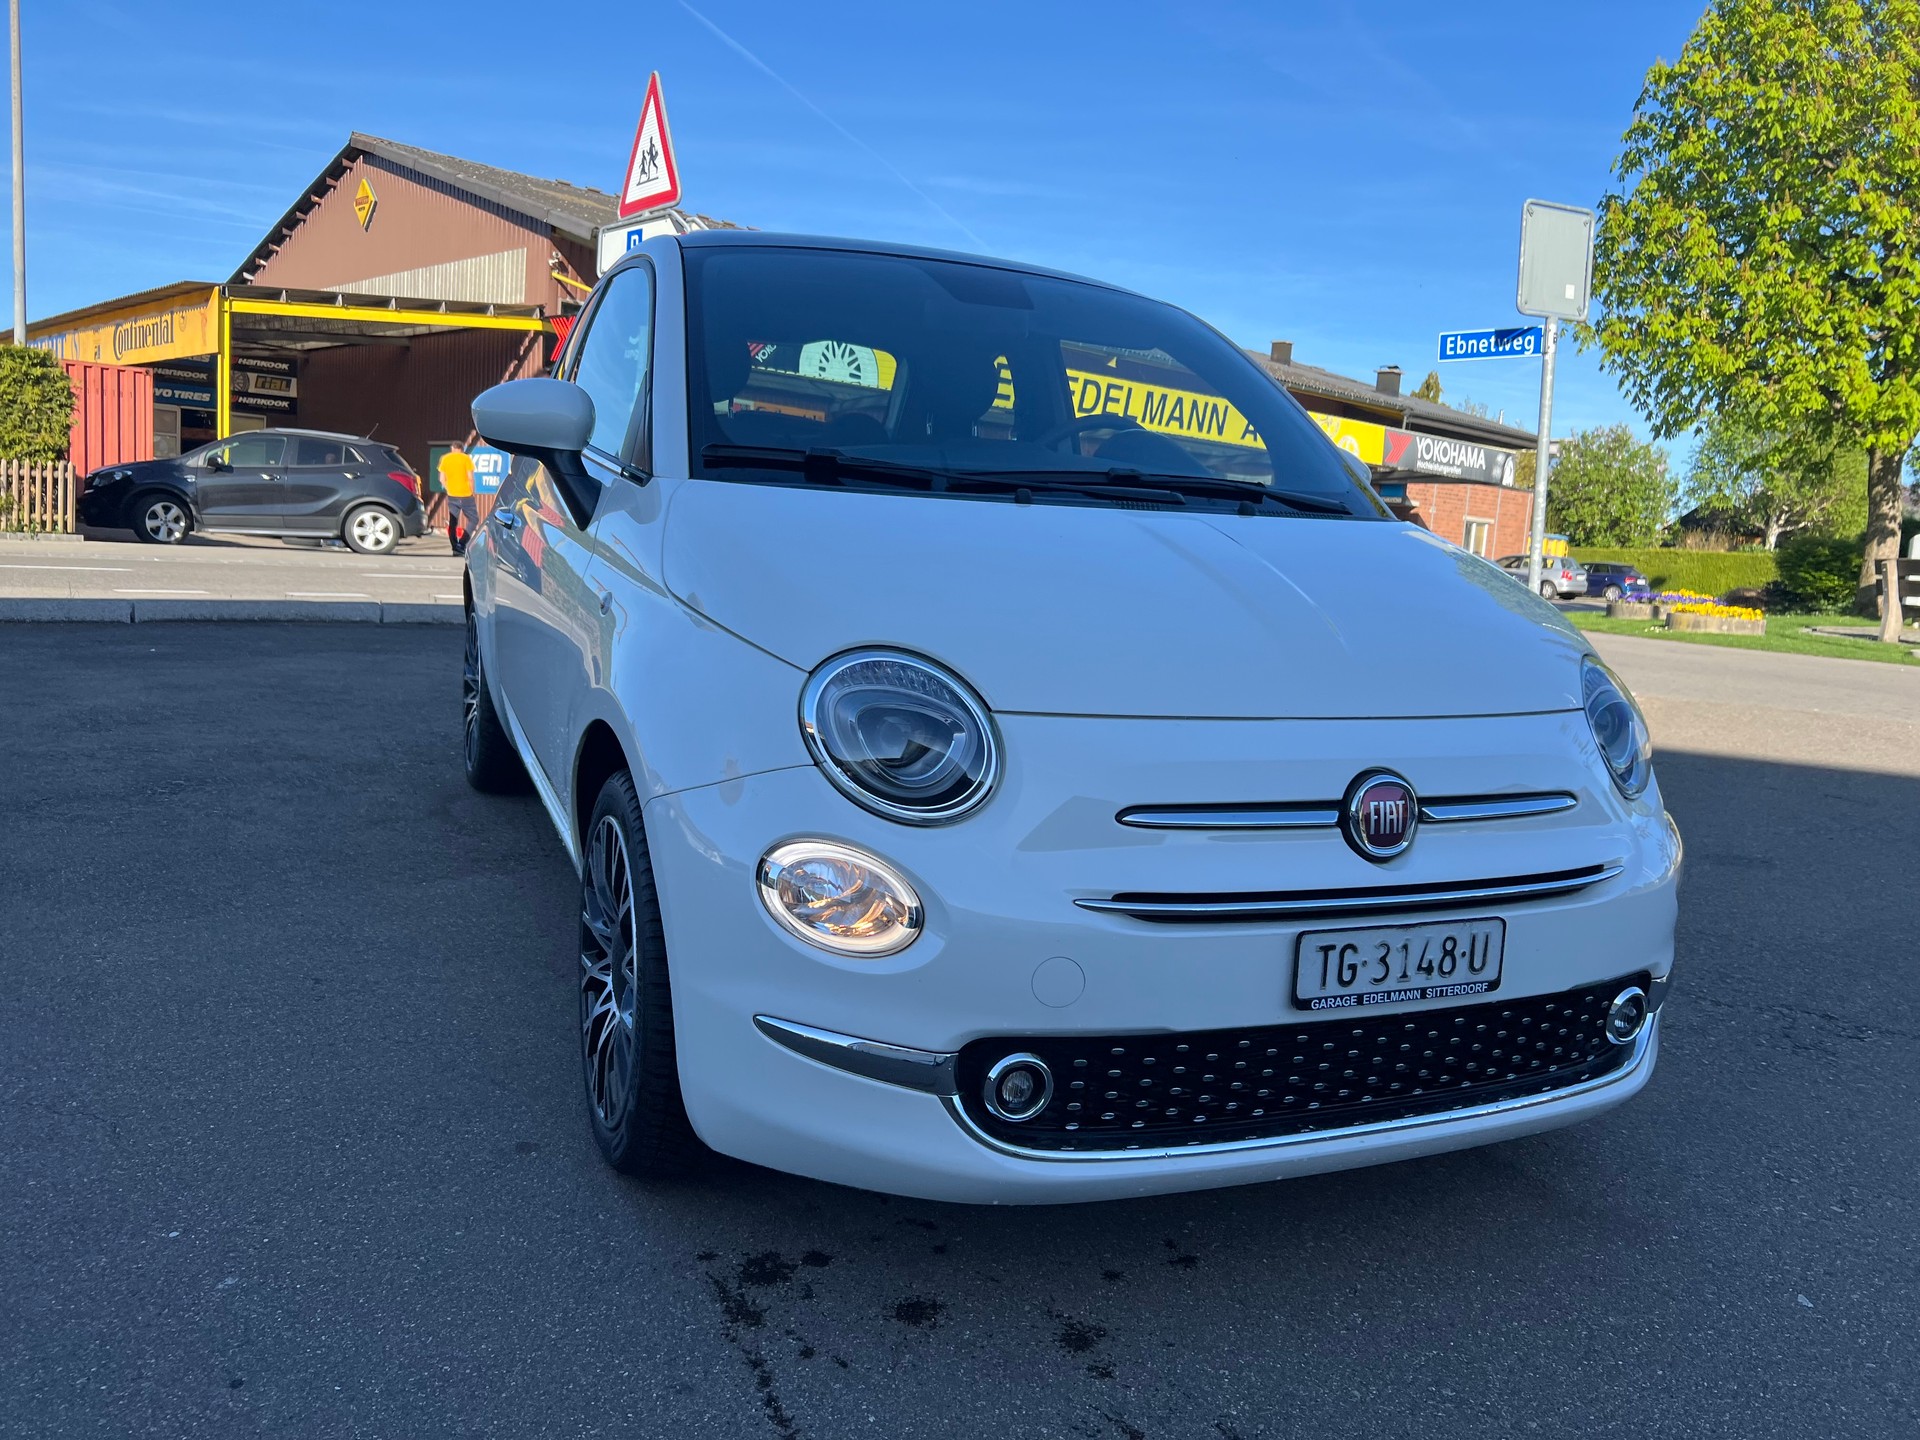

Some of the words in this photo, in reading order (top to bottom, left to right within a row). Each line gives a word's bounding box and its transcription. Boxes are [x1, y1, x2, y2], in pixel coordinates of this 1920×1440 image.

[113, 310, 175, 361] Continental
[1446, 335, 1535, 355] Ebnetweg
[1416, 436, 1486, 470] YOKOHAMA
[1369, 800, 1406, 835] FIAT
[1310, 996, 1358, 1010] GARAGE
[1362, 989, 1421, 1005] EDELMANN
[1425, 982, 1489, 999] SITTERDORF
